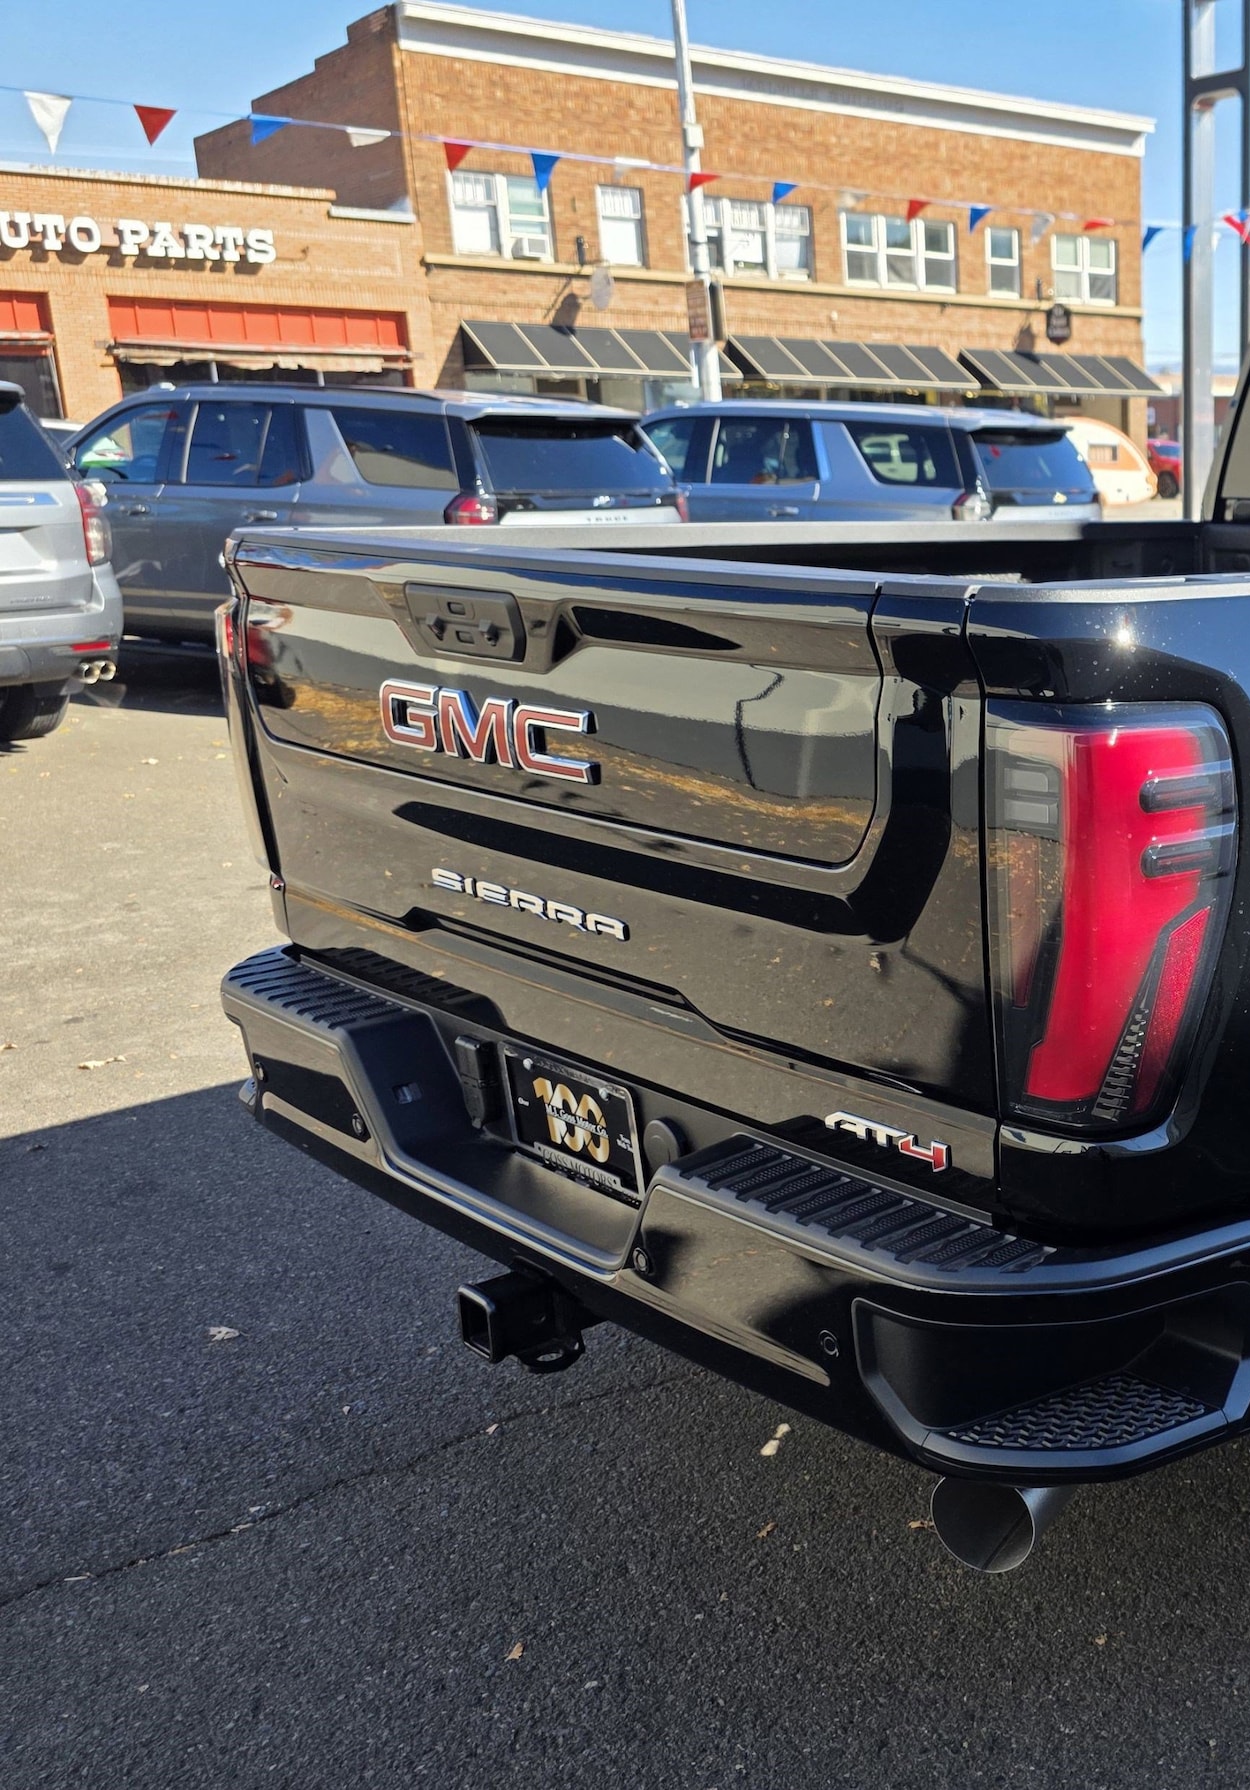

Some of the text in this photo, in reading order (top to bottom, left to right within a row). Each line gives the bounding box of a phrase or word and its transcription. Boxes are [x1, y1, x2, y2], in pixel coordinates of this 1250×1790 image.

[0, 211, 276, 263] UTO PARTS
[379, 678, 601, 785] GMC
[431, 867, 630, 942] SIERRA
[533, 1077, 610, 1163] 100
[825, 1110, 952, 1173] AT4
